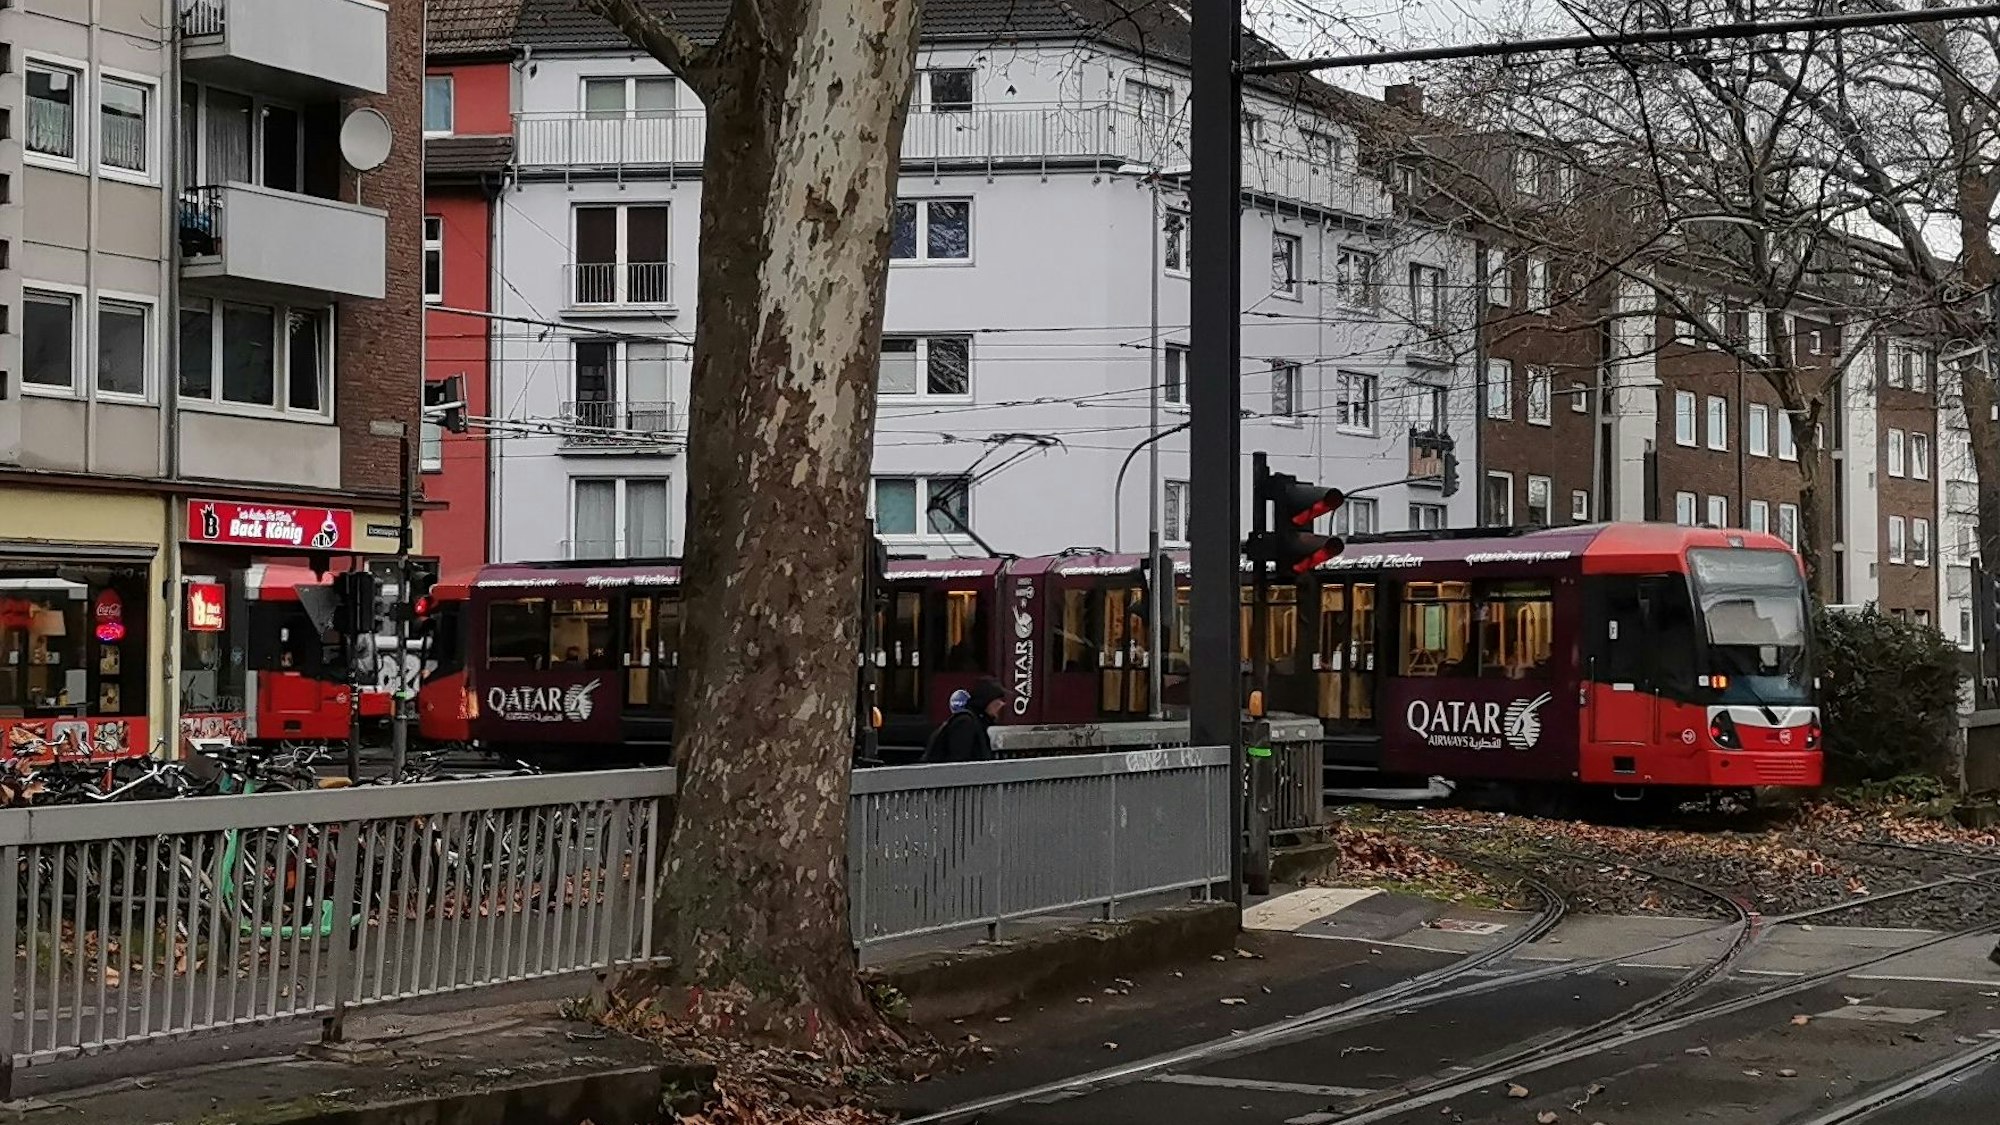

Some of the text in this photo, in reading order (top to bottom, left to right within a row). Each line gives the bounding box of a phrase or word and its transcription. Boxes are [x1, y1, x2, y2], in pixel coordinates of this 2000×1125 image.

[229, 519, 303, 545] Back König
[1383, 554, 1424, 567] Zielen
[1014, 640, 1029, 715] QATAR
[488, 686, 562, 717] QATAR
[1407, 700, 1501, 739] QATAR
[1428, 735, 1468, 748] AIRWAYS
